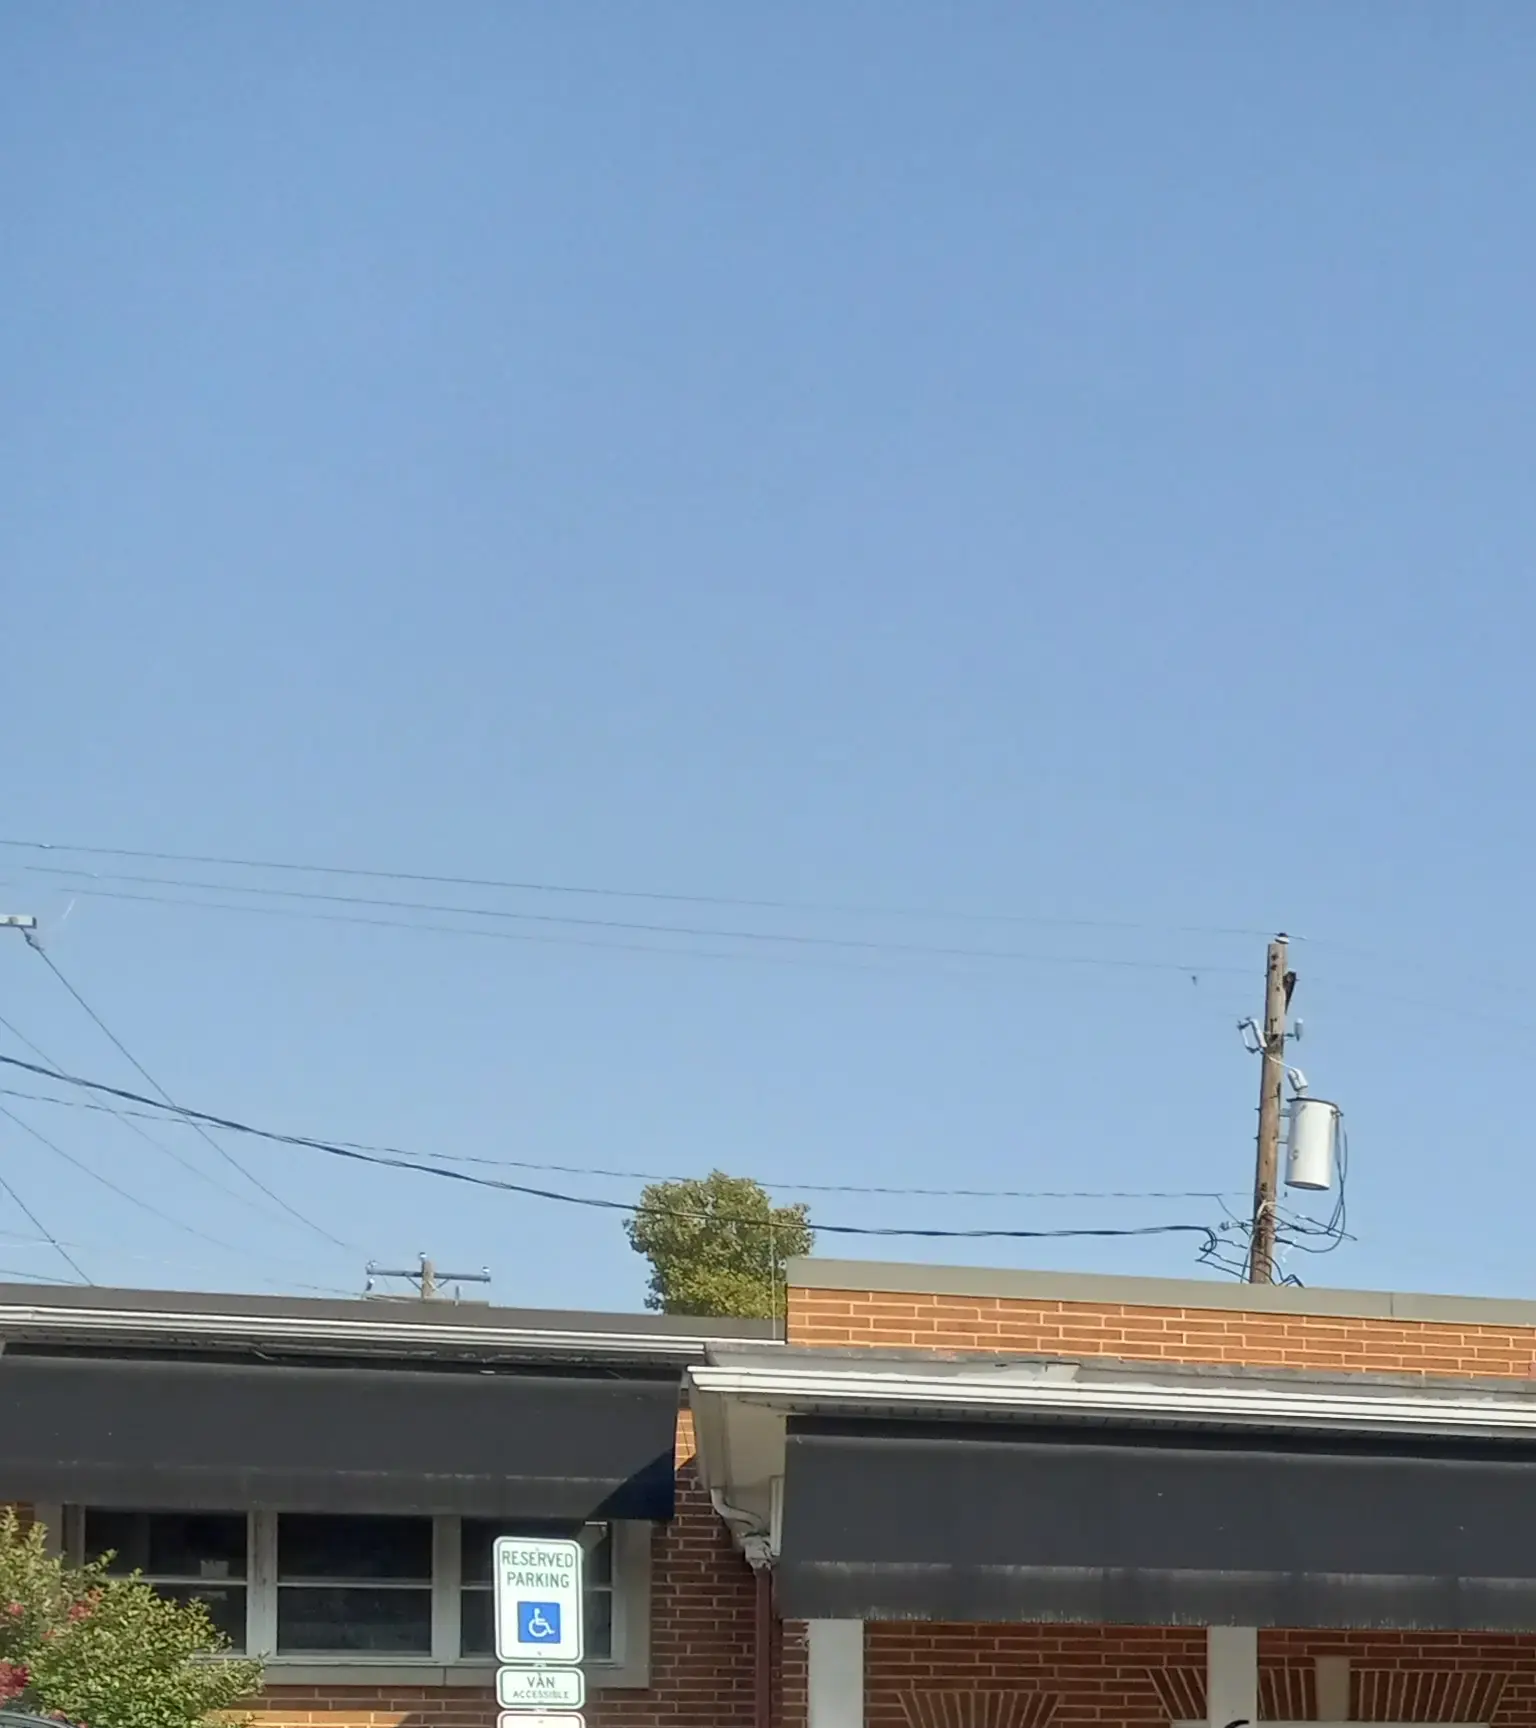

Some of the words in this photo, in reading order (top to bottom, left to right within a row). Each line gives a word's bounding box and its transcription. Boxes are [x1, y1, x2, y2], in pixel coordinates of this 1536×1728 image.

[502, 1551, 574, 1568] RESERVED
[507, 1571, 570, 1589] PARKING
[526, 1676, 555, 1689] VAN
